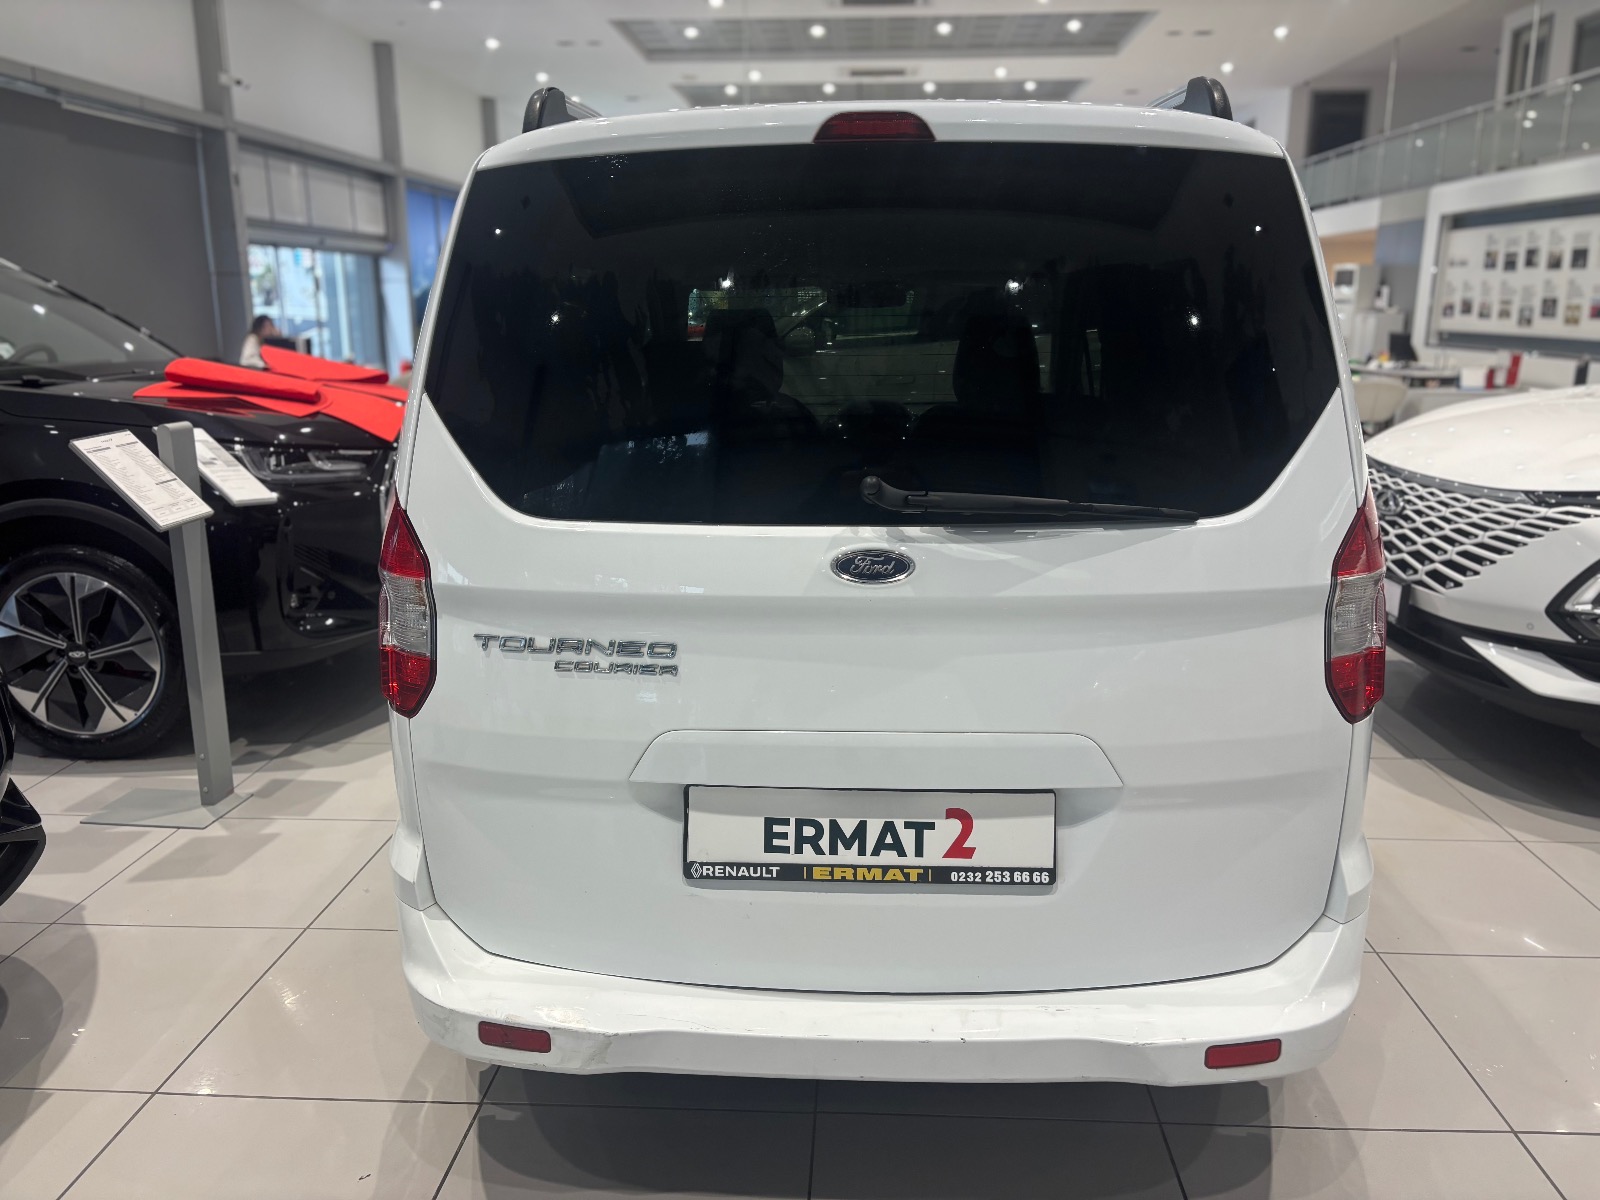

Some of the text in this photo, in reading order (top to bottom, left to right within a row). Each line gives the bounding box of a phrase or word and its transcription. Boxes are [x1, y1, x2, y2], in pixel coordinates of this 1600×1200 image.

[849, 555, 895, 574] Ford
[473, 633, 678, 659] TOURNEO
[553, 660, 679, 676] COURIER
[763, 807, 977, 860] ERMAT 2
[702, 865, 780, 879] RENAULT
[812, 866, 925, 882] ERMAT
[950, 870, 1050, 884] 0232 253 66 66
